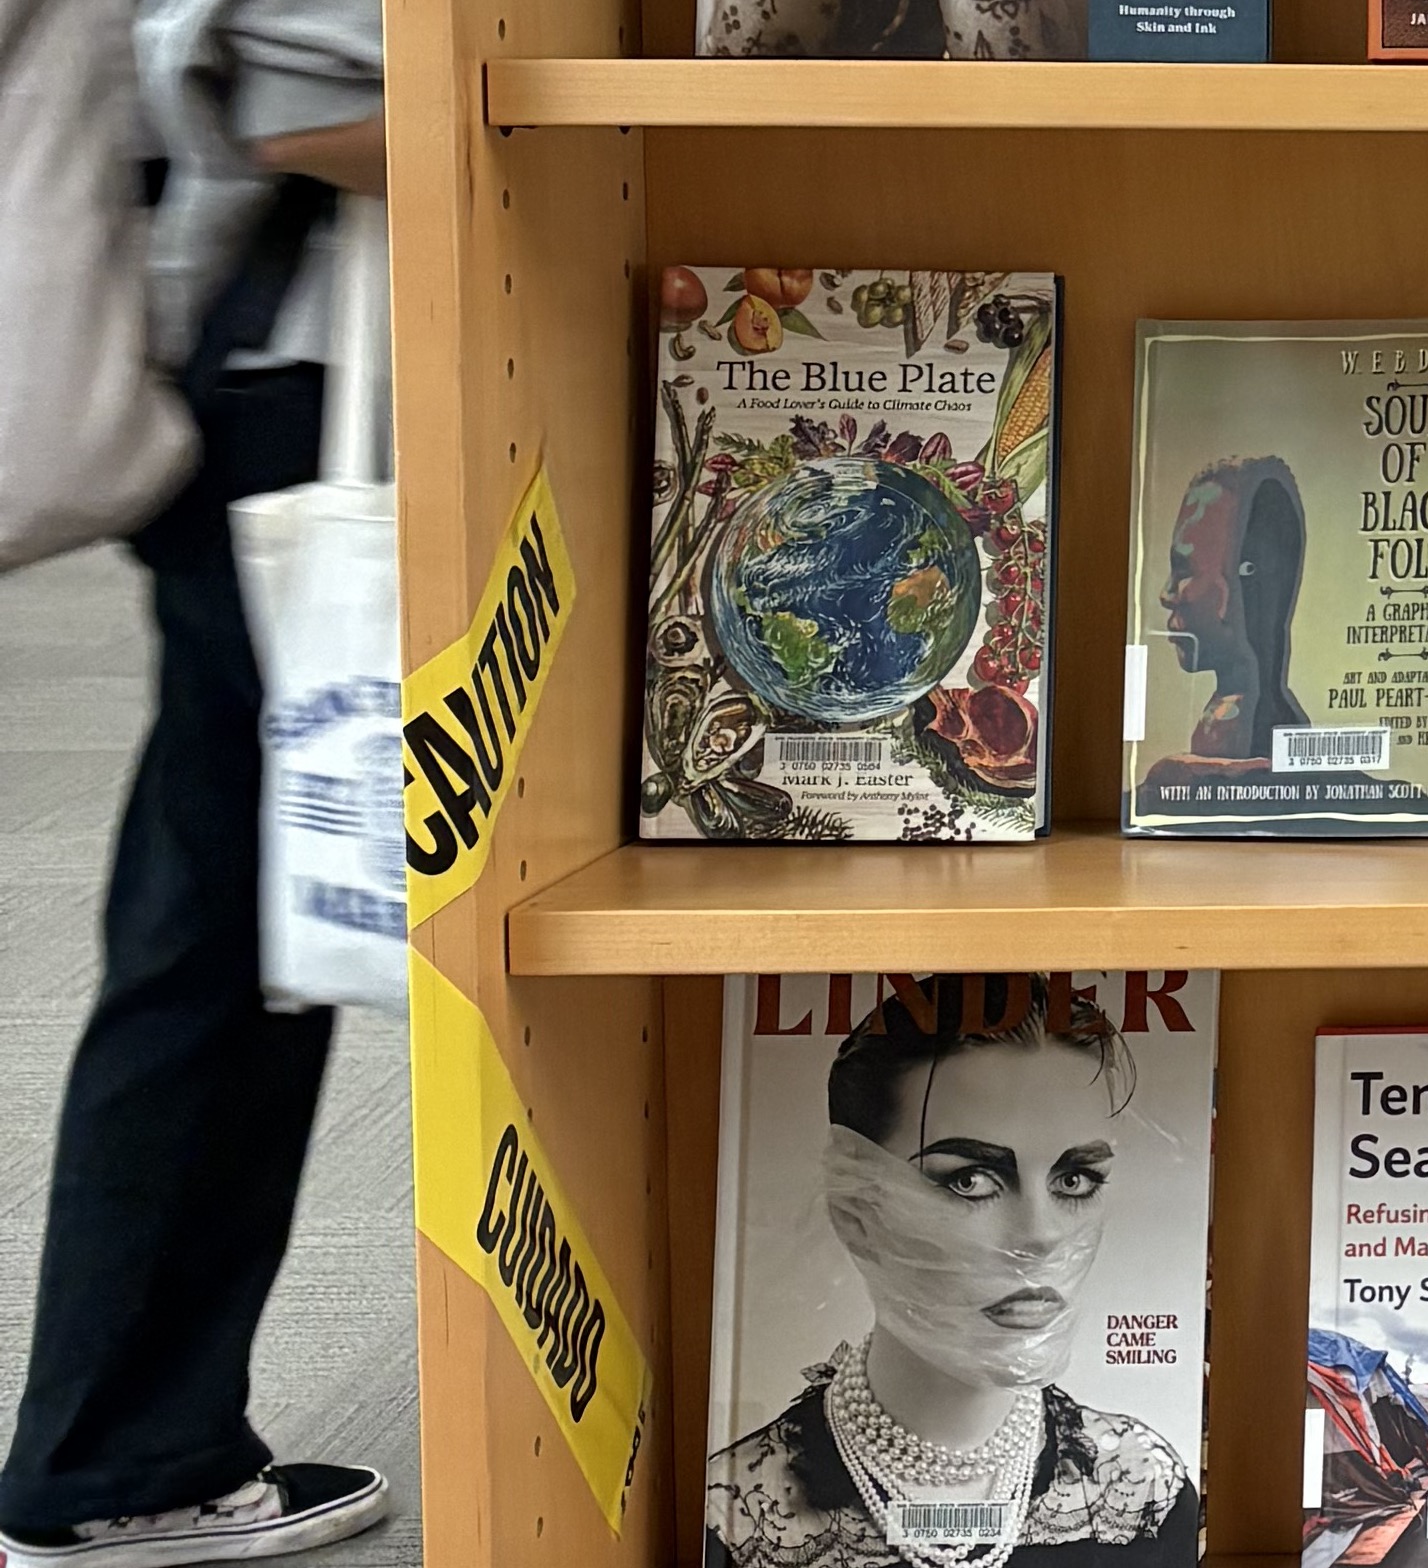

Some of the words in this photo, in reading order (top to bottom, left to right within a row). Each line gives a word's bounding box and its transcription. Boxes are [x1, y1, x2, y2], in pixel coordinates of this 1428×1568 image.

[1119, 5, 1181, 18] Humanity
[1185, 6, 1235, 18] through
[1136, 22, 1165, 32] Skin
[1168, 23, 1191, 32] and
[1195, 23, 1216, 33] Ink
[716, 360, 791, 391] The
[801, 361, 887, 392] Blue
[898, 363, 995, 394] Plate
[737, 398, 747, 409] A
[750, 398, 780, 409] Food
[829, 399, 864, 409] Guide
[868, 400, 879, 410] to
[883, 400, 931, 411] Climate
[934, 400, 971, 412] Chaos
[1381, 442, 1427, 484] OF
[404, 511, 559, 875] CAUTION
[1328, 687, 1367, 709] PAUL
[1344, 1237, 1387, 1258] and
[476, 1122, 606, 1422] CUIDADO
[1344, 1279, 1411, 1309] Tony
[1107, 1315, 1178, 1330] DANGER
[1107, 1332, 1155, 1347] CAME
[1106, 1350, 1177, 1365] SMILING
